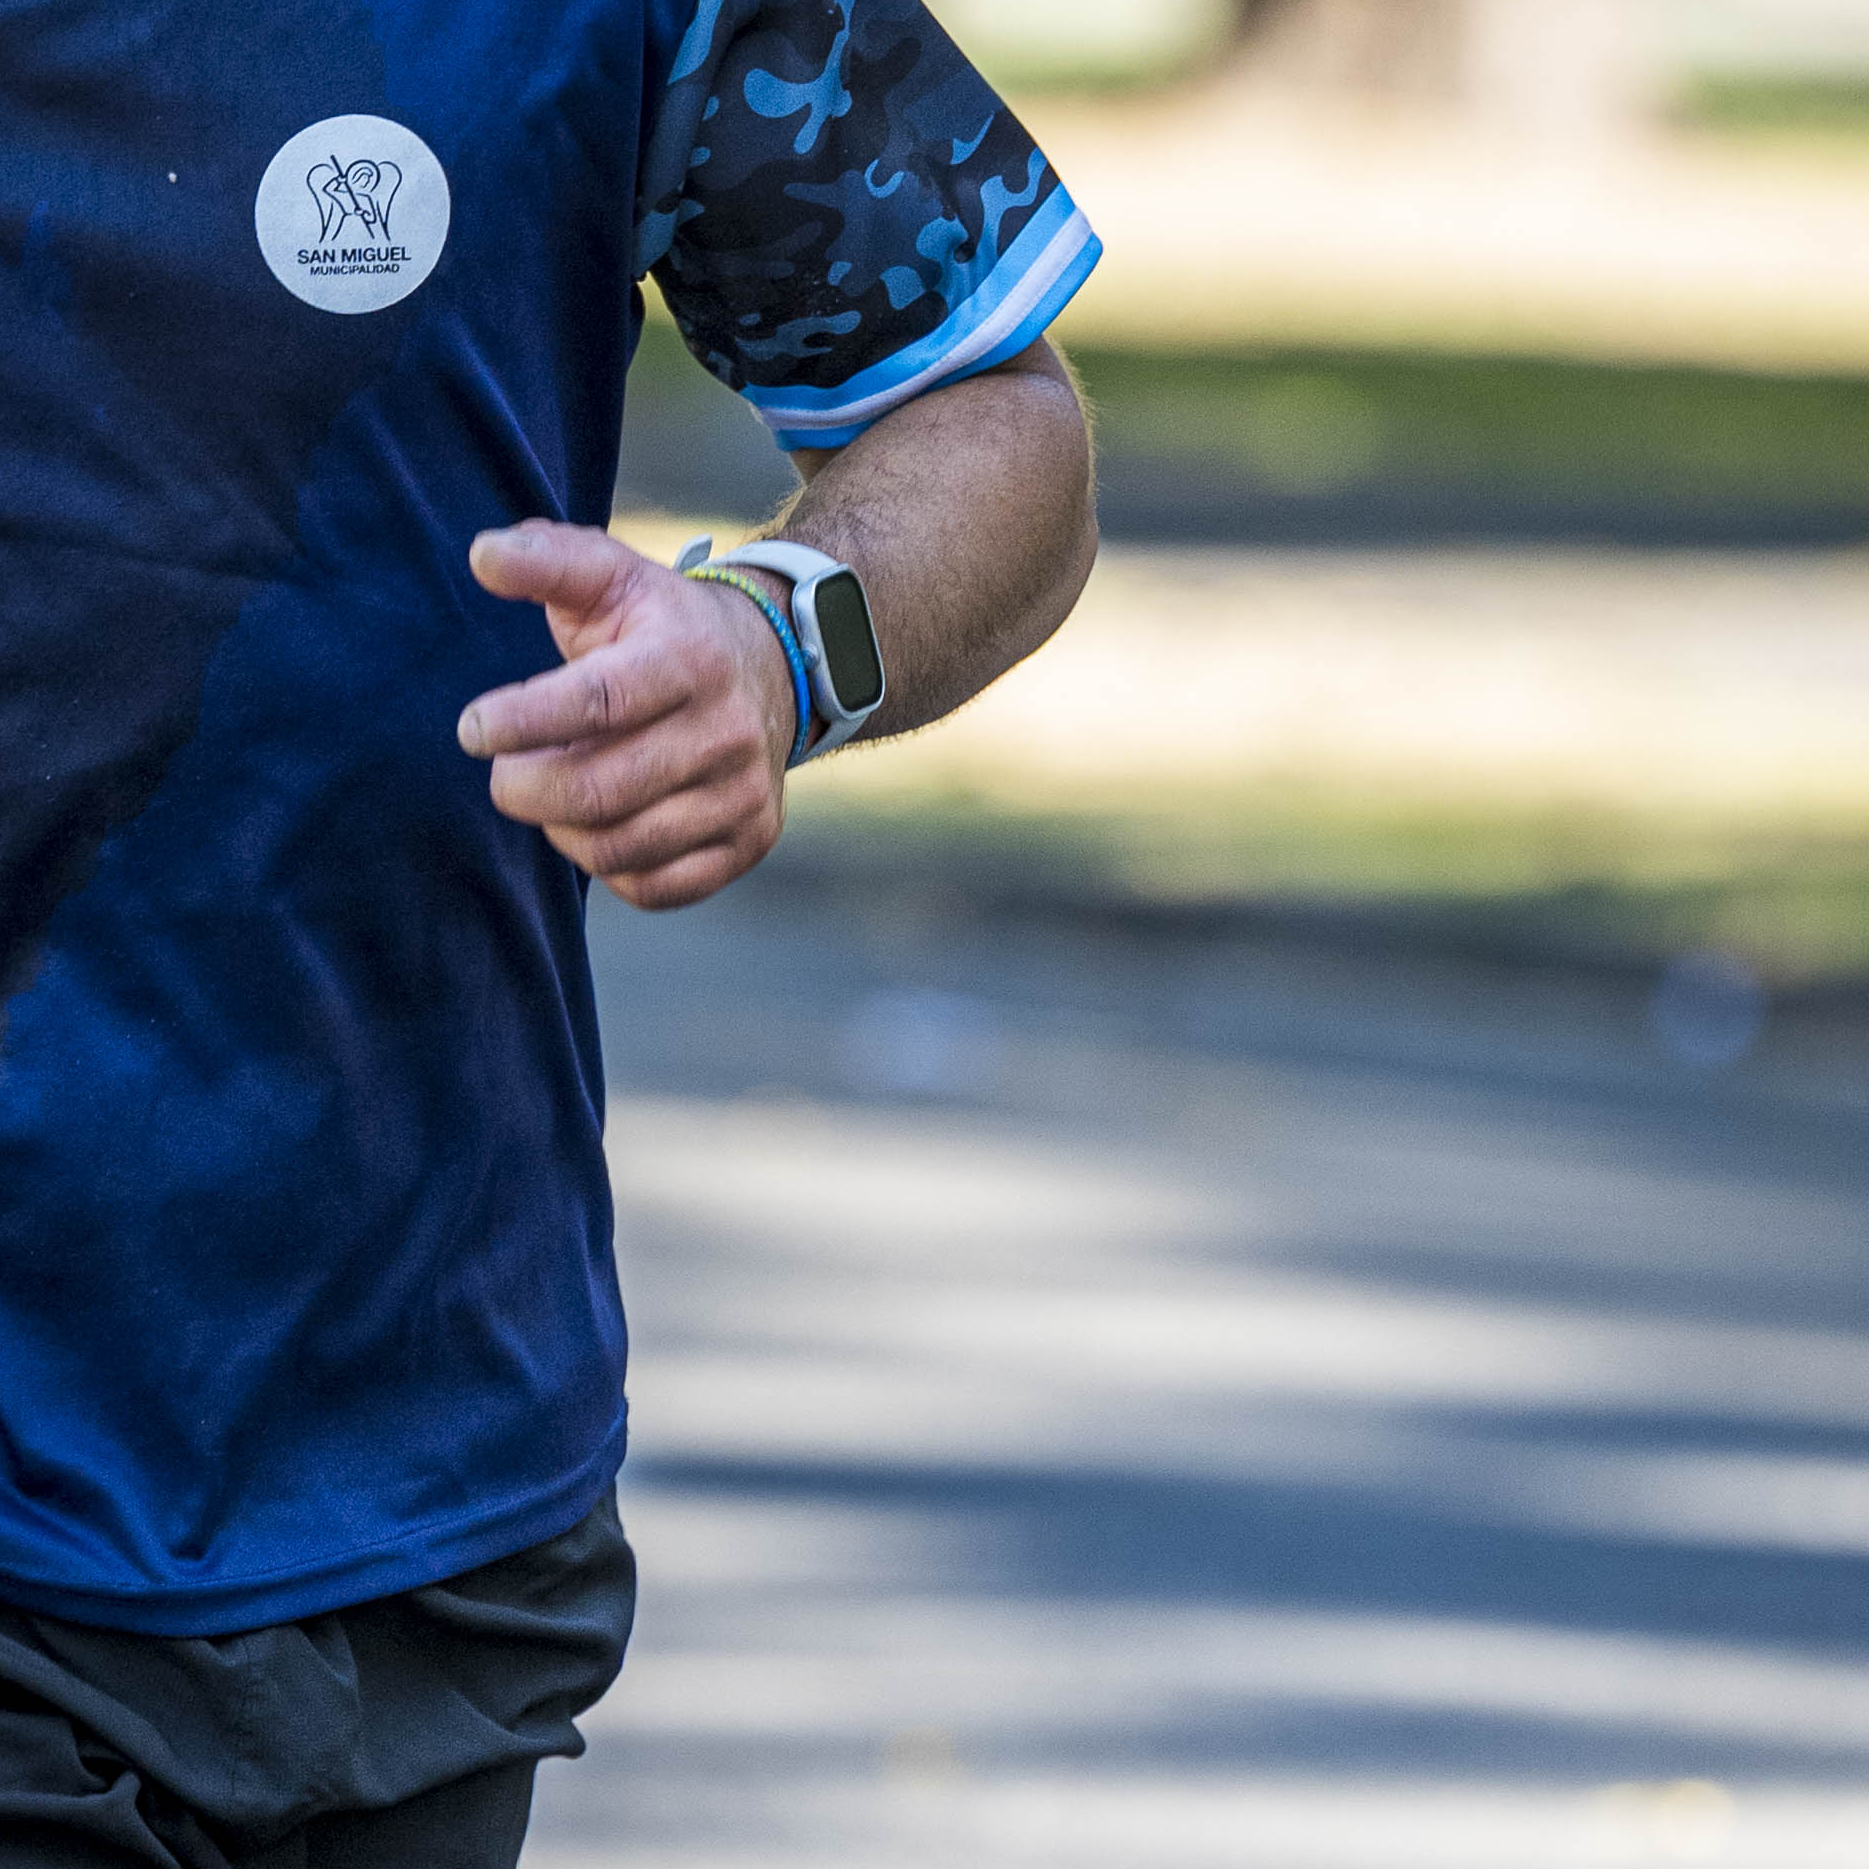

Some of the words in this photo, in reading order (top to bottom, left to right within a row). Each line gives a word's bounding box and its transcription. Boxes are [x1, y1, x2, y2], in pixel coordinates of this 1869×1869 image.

[297, 249, 336, 264] SAN
[341, 247, 412, 262] MIGUEL
[310, 263, 400, 275] MUNICIPALIDAD
